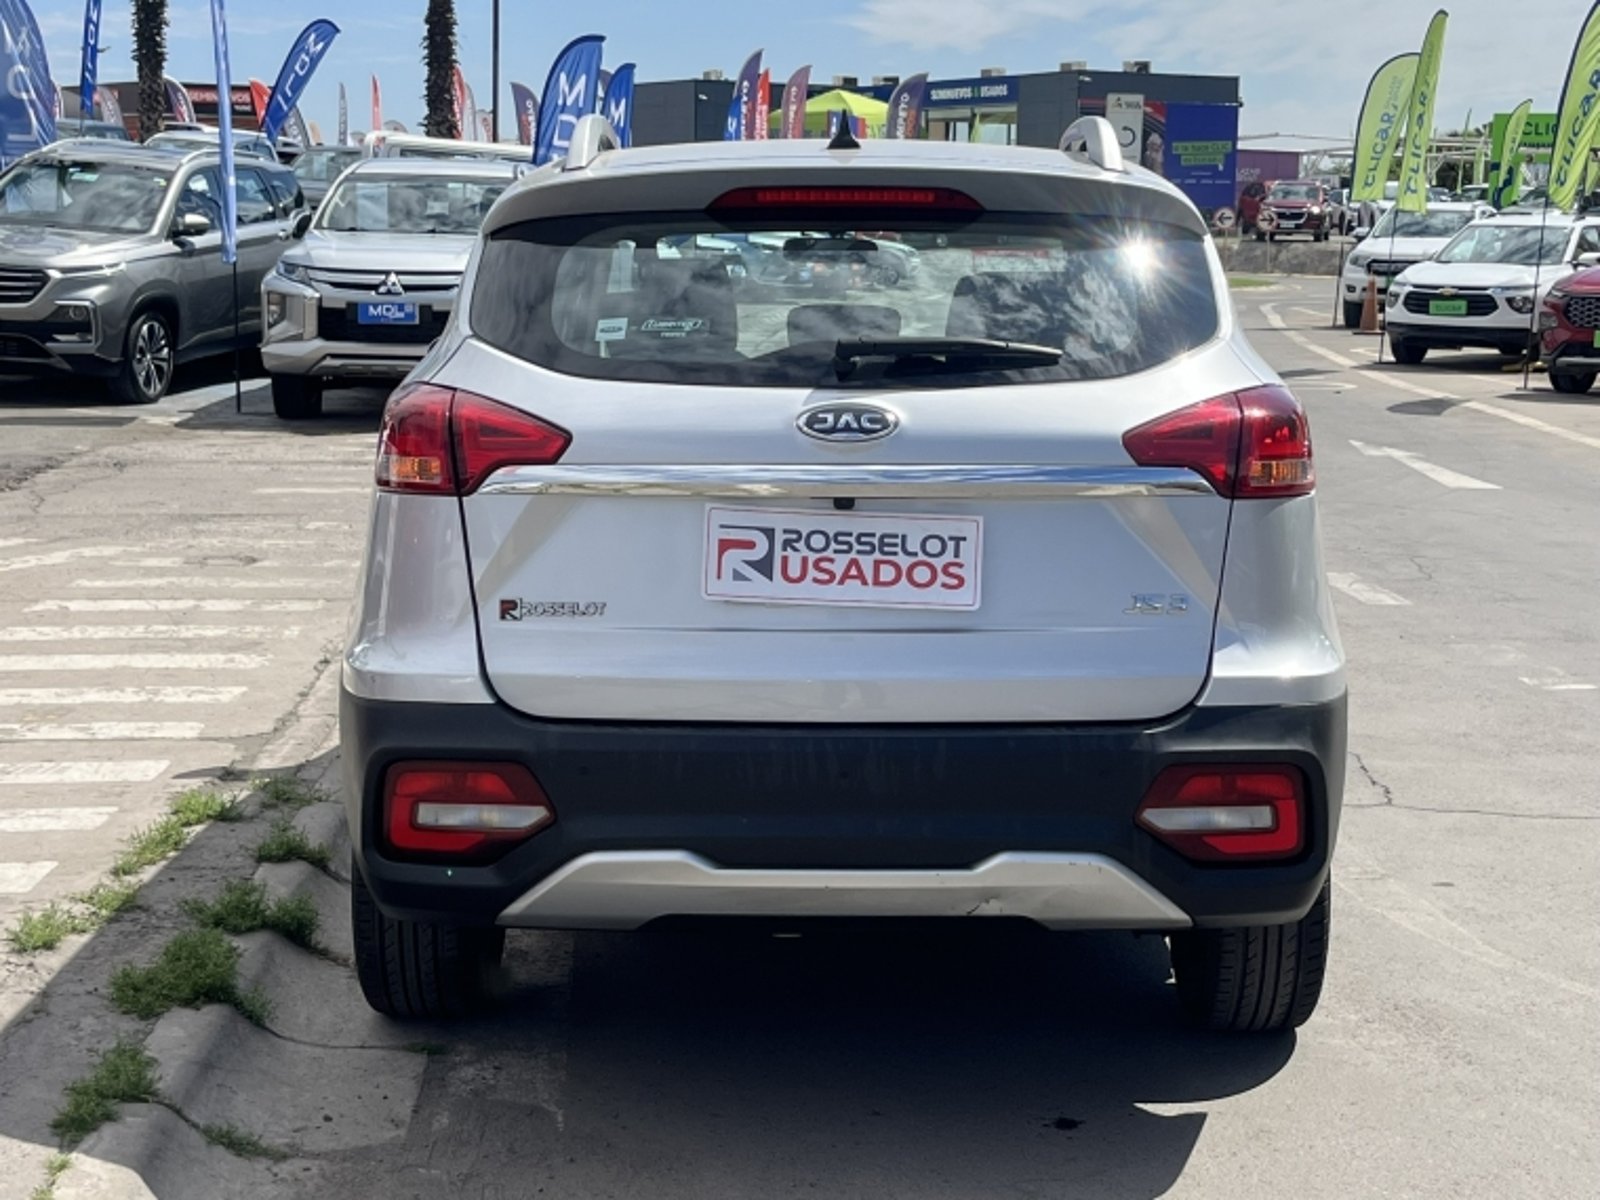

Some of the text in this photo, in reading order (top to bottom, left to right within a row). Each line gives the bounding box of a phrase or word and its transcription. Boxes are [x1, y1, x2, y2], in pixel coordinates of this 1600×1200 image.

[813, 411, 883, 430] JAC
[781, 528, 967, 558] ROSSELOT
[781, 555, 966, 590] USADOS
[521, 601, 607, 618] ROSSELOT
